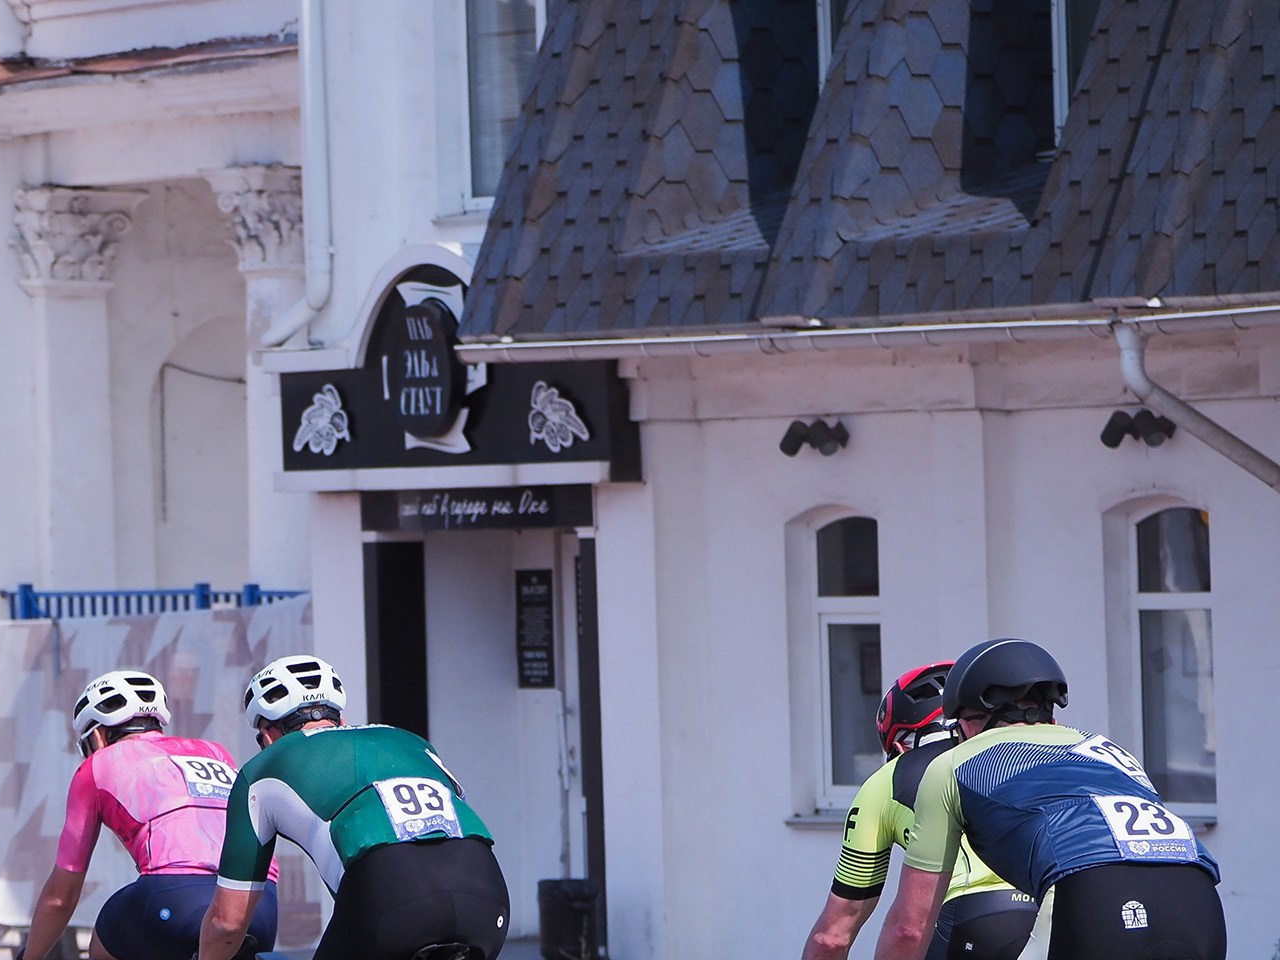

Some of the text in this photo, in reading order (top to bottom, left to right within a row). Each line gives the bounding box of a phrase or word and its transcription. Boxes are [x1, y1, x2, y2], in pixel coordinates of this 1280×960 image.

[401, 386, 442, 416] СТАУТ
[302, 692, 325, 702] KASK
[1089, 741, 1144, 772] 23
[185, 759, 233, 785] 98
[392, 783, 444, 815] 93
[1113, 801, 1175, 836] 23
